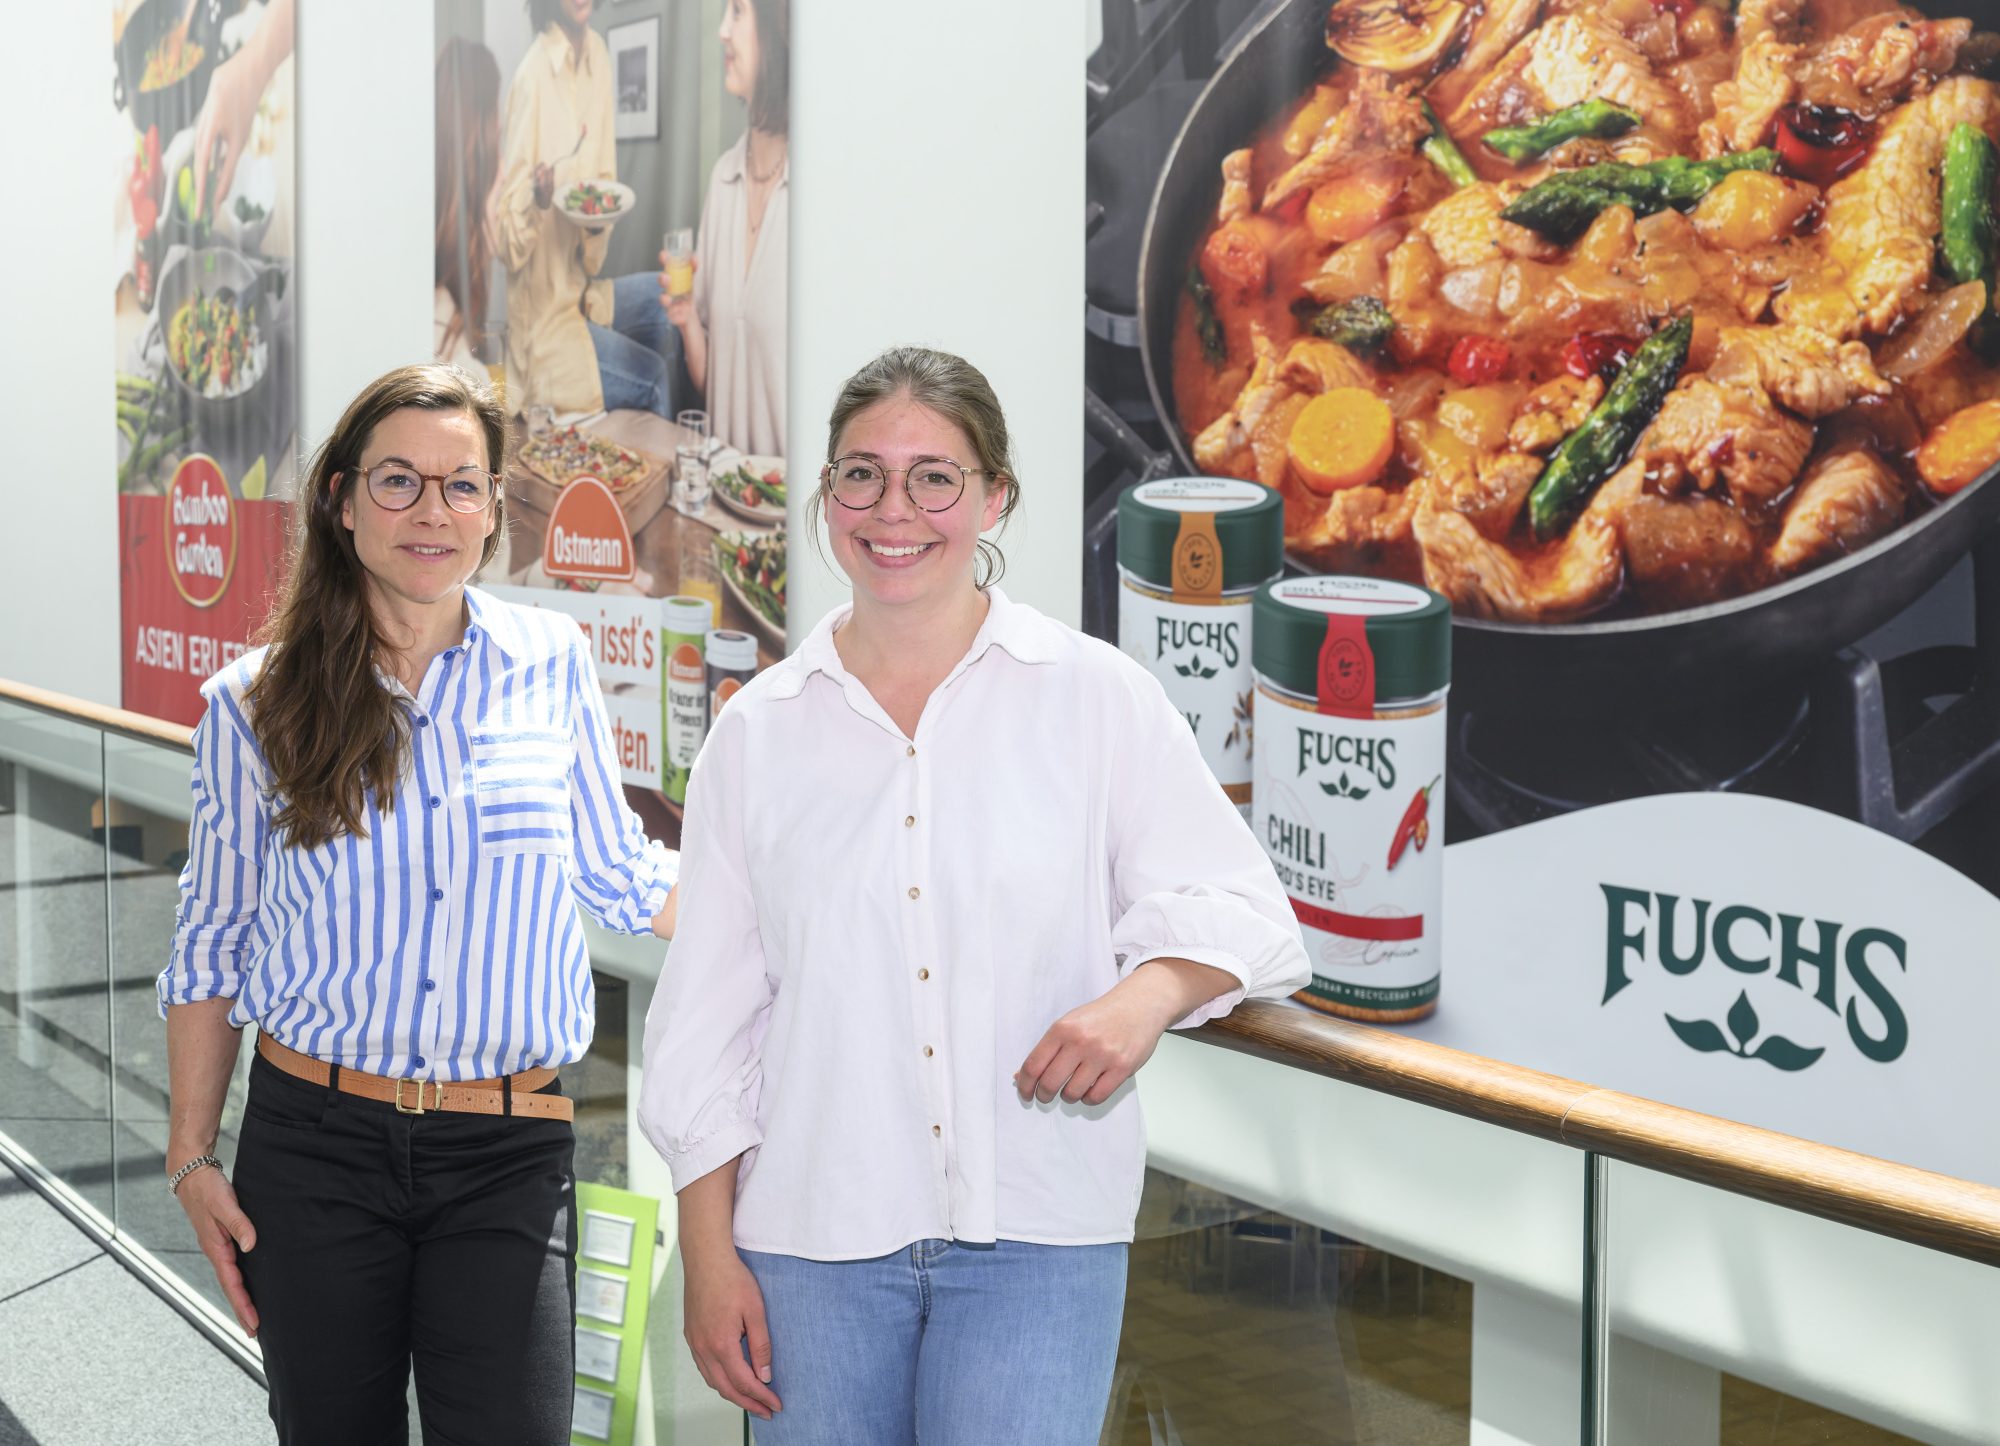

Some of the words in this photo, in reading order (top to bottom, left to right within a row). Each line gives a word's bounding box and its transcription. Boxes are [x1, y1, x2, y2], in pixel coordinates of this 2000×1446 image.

[173, 481, 228, 526] Bamboo
[176, 532, 224, 579] Garten
[553, 526, 623, 568] Ostmann
[136, 625, 184, 673] ASIEN
[1156, 616, 1239, 669] FUCHS
[1297, 727, 1396, 790] FUCHS
[1268, 814, 1326, 869] CHILI
[1308, 874, 1335, 901] EYE
[1599, 883, 1908, 1063] FUCHS
